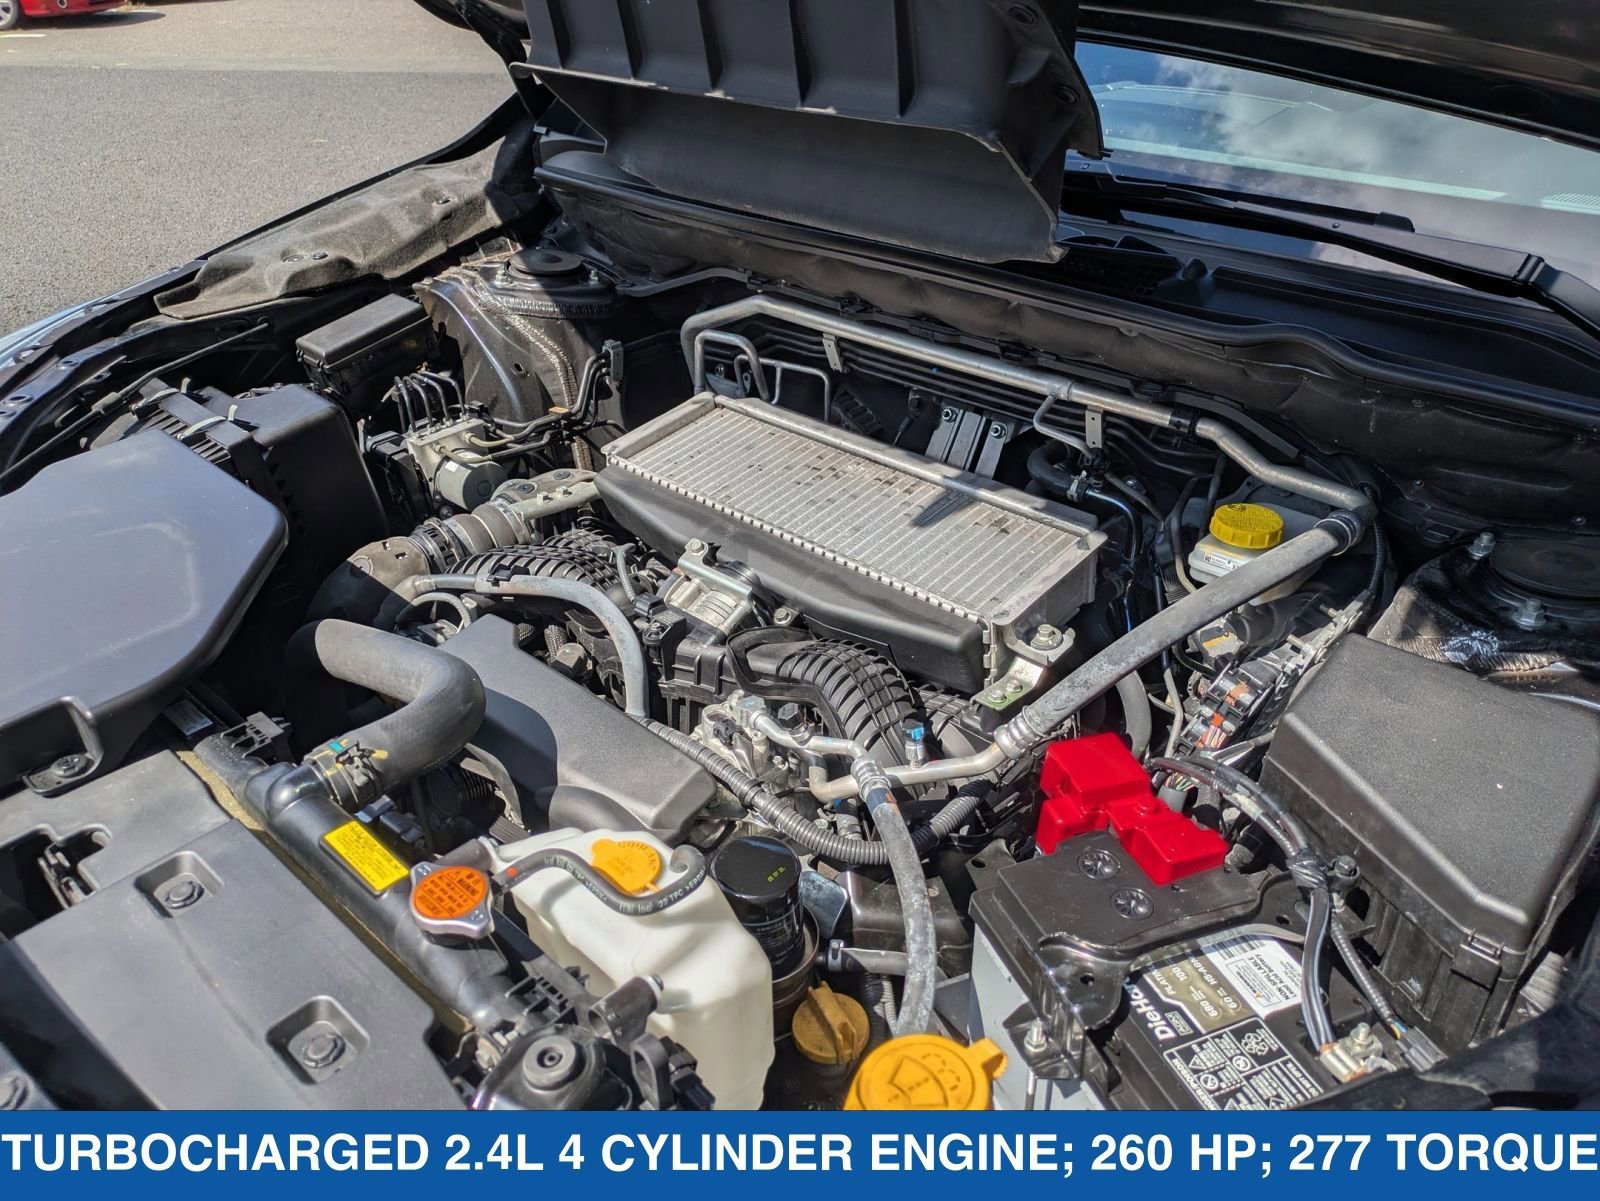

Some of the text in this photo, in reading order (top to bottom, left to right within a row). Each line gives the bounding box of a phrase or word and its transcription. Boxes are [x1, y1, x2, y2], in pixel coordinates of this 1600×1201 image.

[1255, 954, 1274, 972] Battery
[1172, 966, 1188, 981] 100
[1248, 956, 1290, 1000] NON-SPILLABLE
[1271, 973, 1285, 984] Acid
[1281, 984, 1297, 998] Lead
[1199, 1000, 1219, 1017] 680
[1223, 996, 1238, 1009] 60
